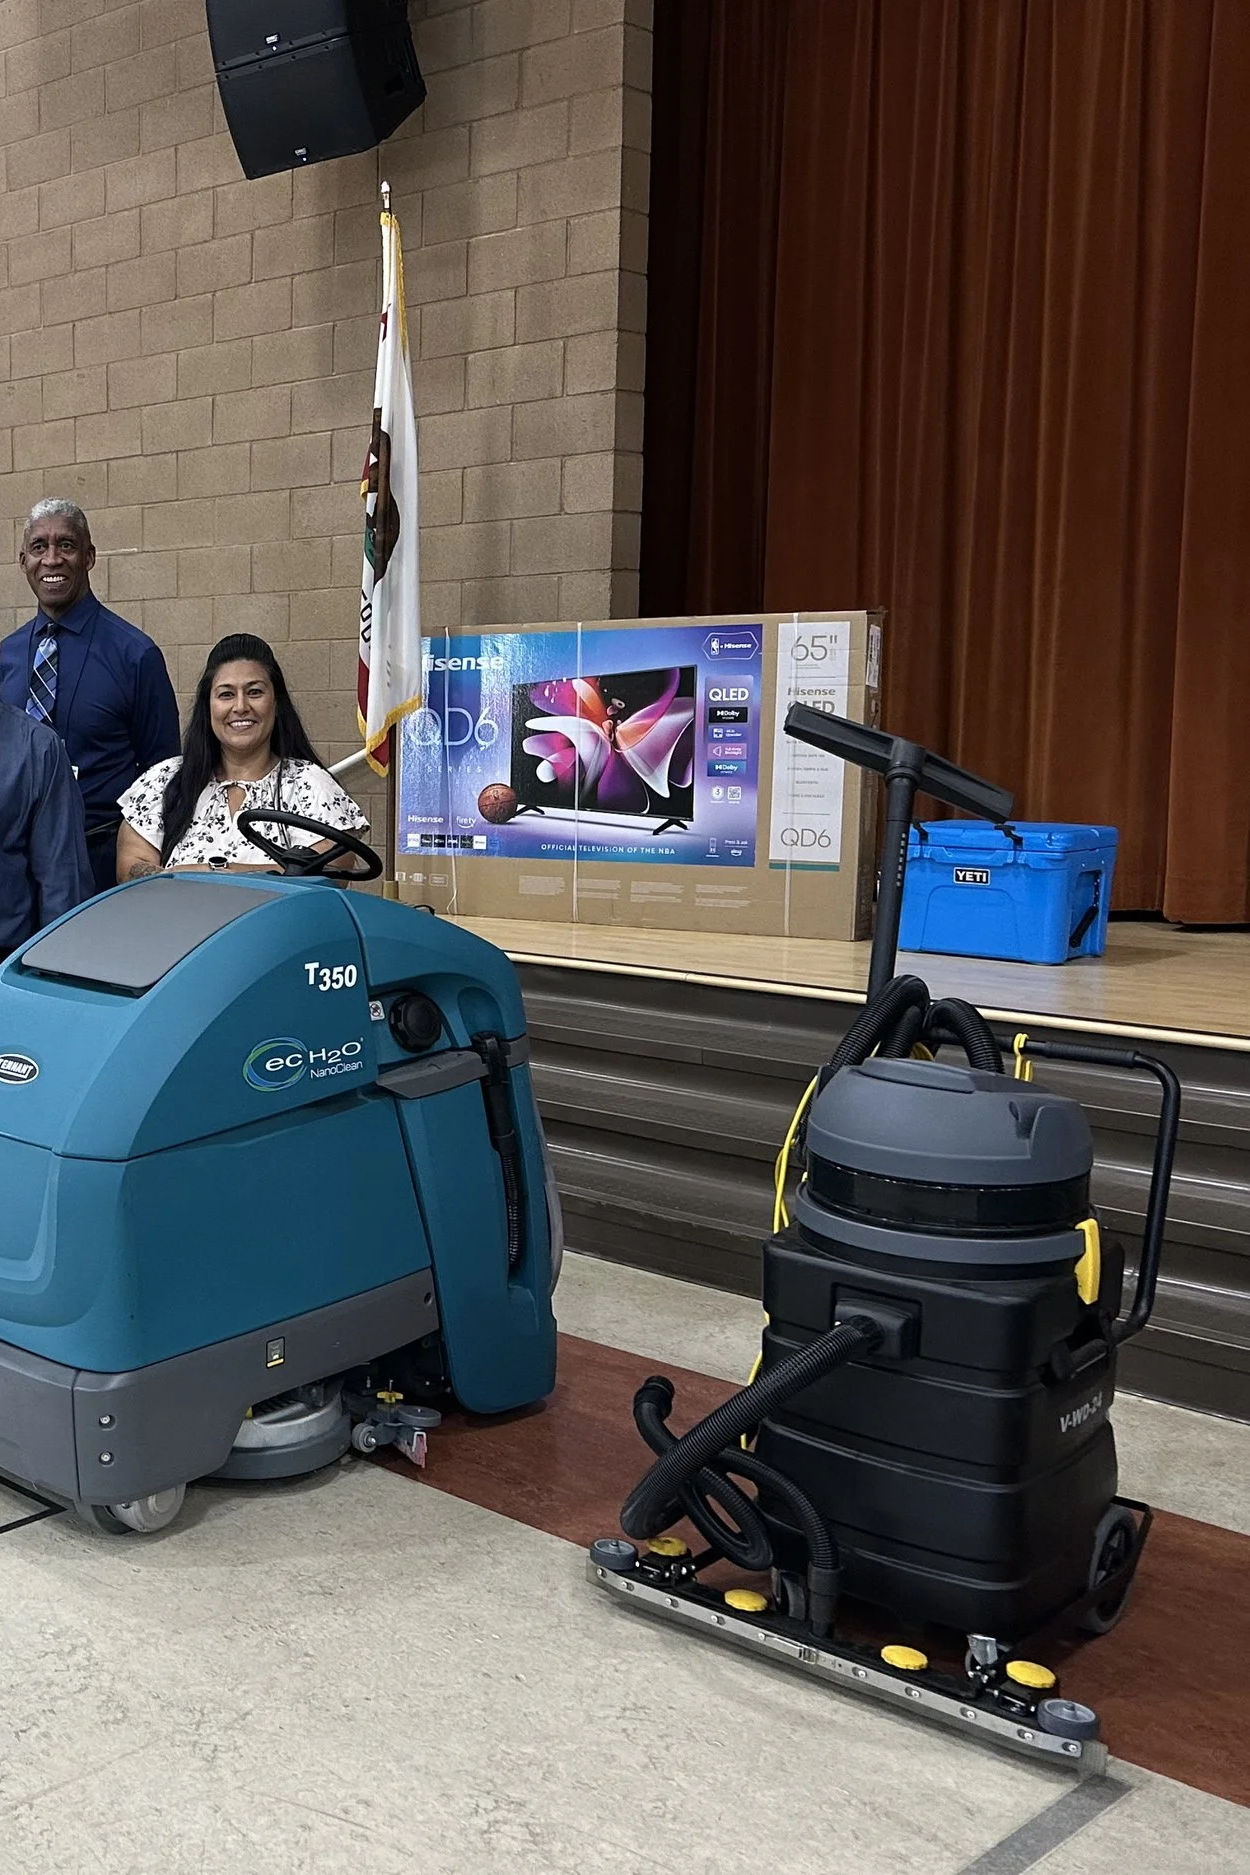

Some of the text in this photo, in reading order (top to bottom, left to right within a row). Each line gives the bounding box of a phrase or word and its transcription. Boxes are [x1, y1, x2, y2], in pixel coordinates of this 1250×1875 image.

[709, 687, 750, 703] QLED
[787, 687, 836, 696] Hisense
[408, 706, 499, 750] QD6
[427, 765, 482, 773] SERIES
[407, 815, 444, 823] Hisense
[780, 827, 832, 848] QD6
[541, 843, 576, 851] OFFICIAL
[579, 845, 624, 853] TELEVISION
[658, 847, 675, 855] NBA
[957, 870, 987, 883] YETI
[305, 962, 357, 991] T350
[310, 1060, 363, 1079] NanoClean
